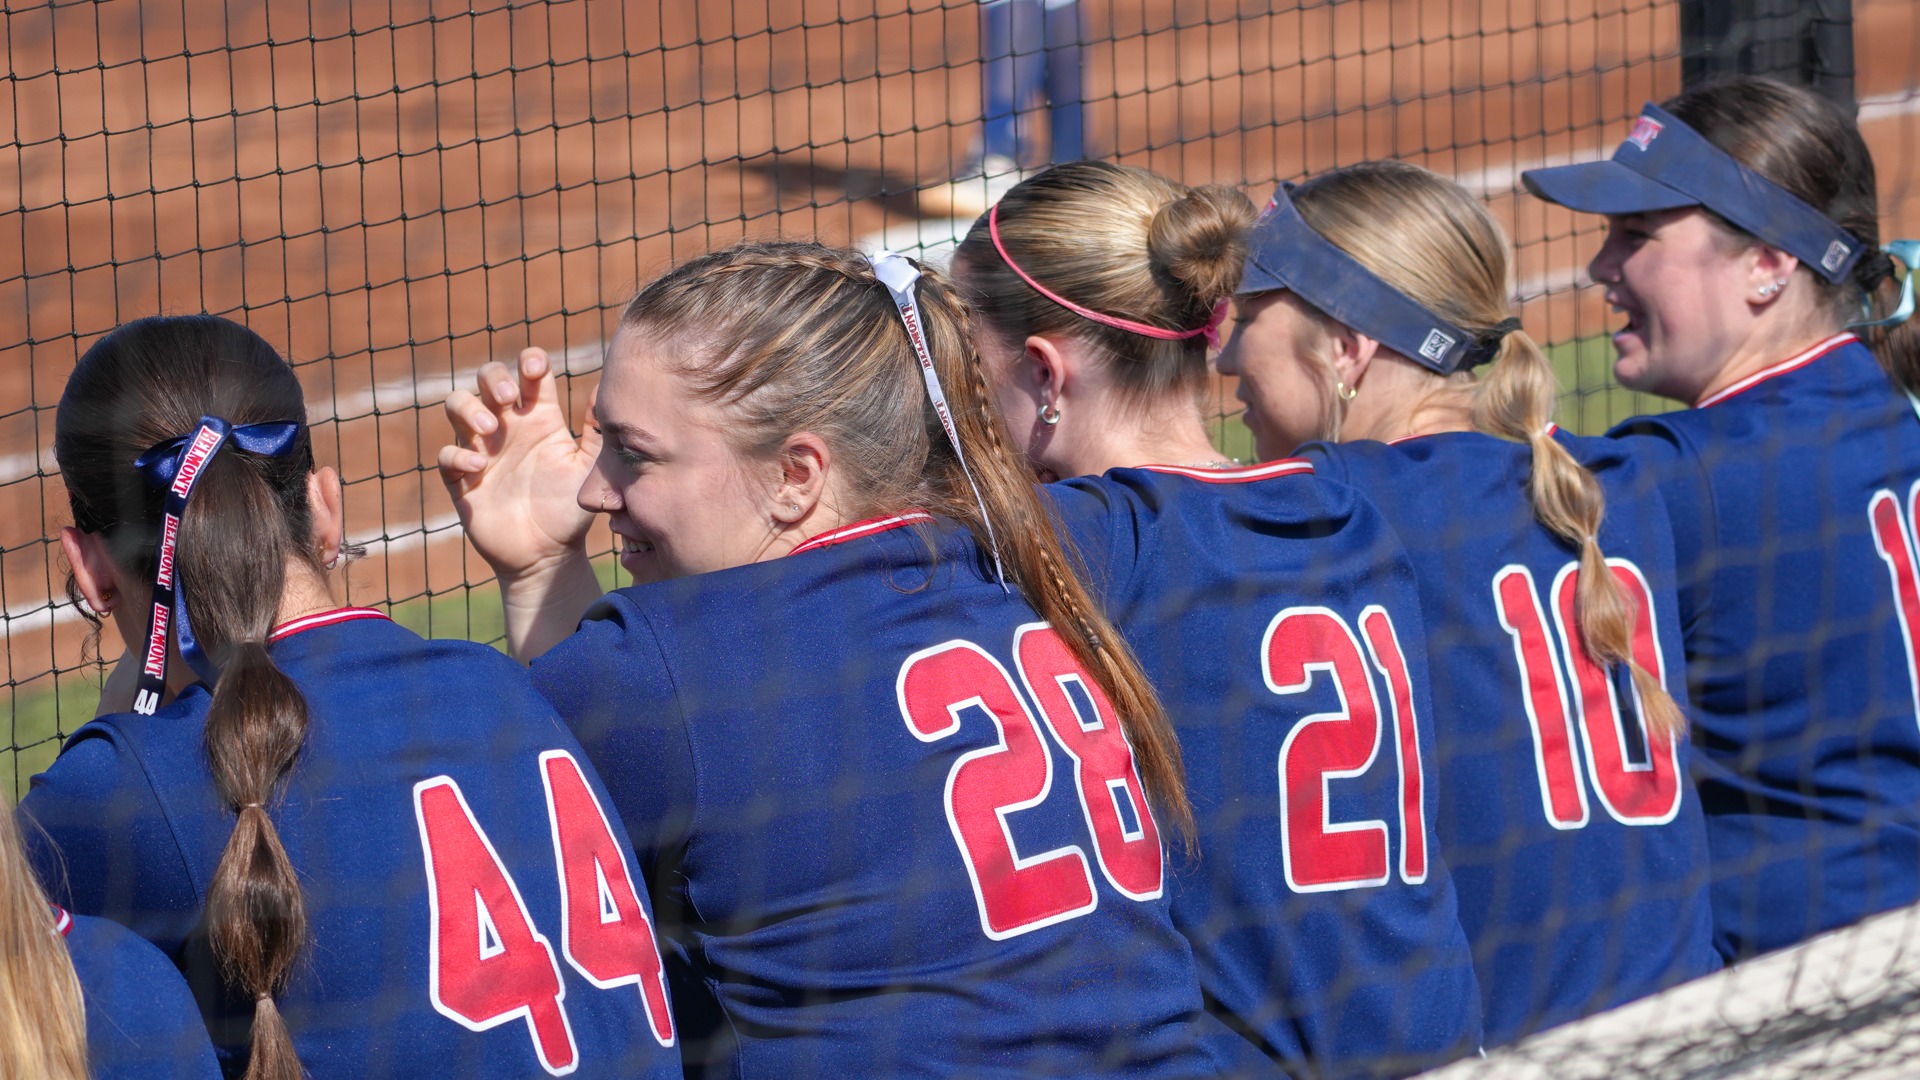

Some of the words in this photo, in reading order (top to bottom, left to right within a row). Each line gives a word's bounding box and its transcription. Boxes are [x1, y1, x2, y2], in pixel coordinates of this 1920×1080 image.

[157, 513, 179, 591] BELMONT
[172, 425, 222, 499] BELMONT
[134, 688, 159, 716] 44
[144, 602, 170, 680] BELMONT
[1492, 557, 1682, 830] 10
[1867, 478, 1920, 734] 1
[896, 621, 1163, 941] 28
[1261, 605, 1428, 893] 21
[413, 749, 674, 1077] 44
